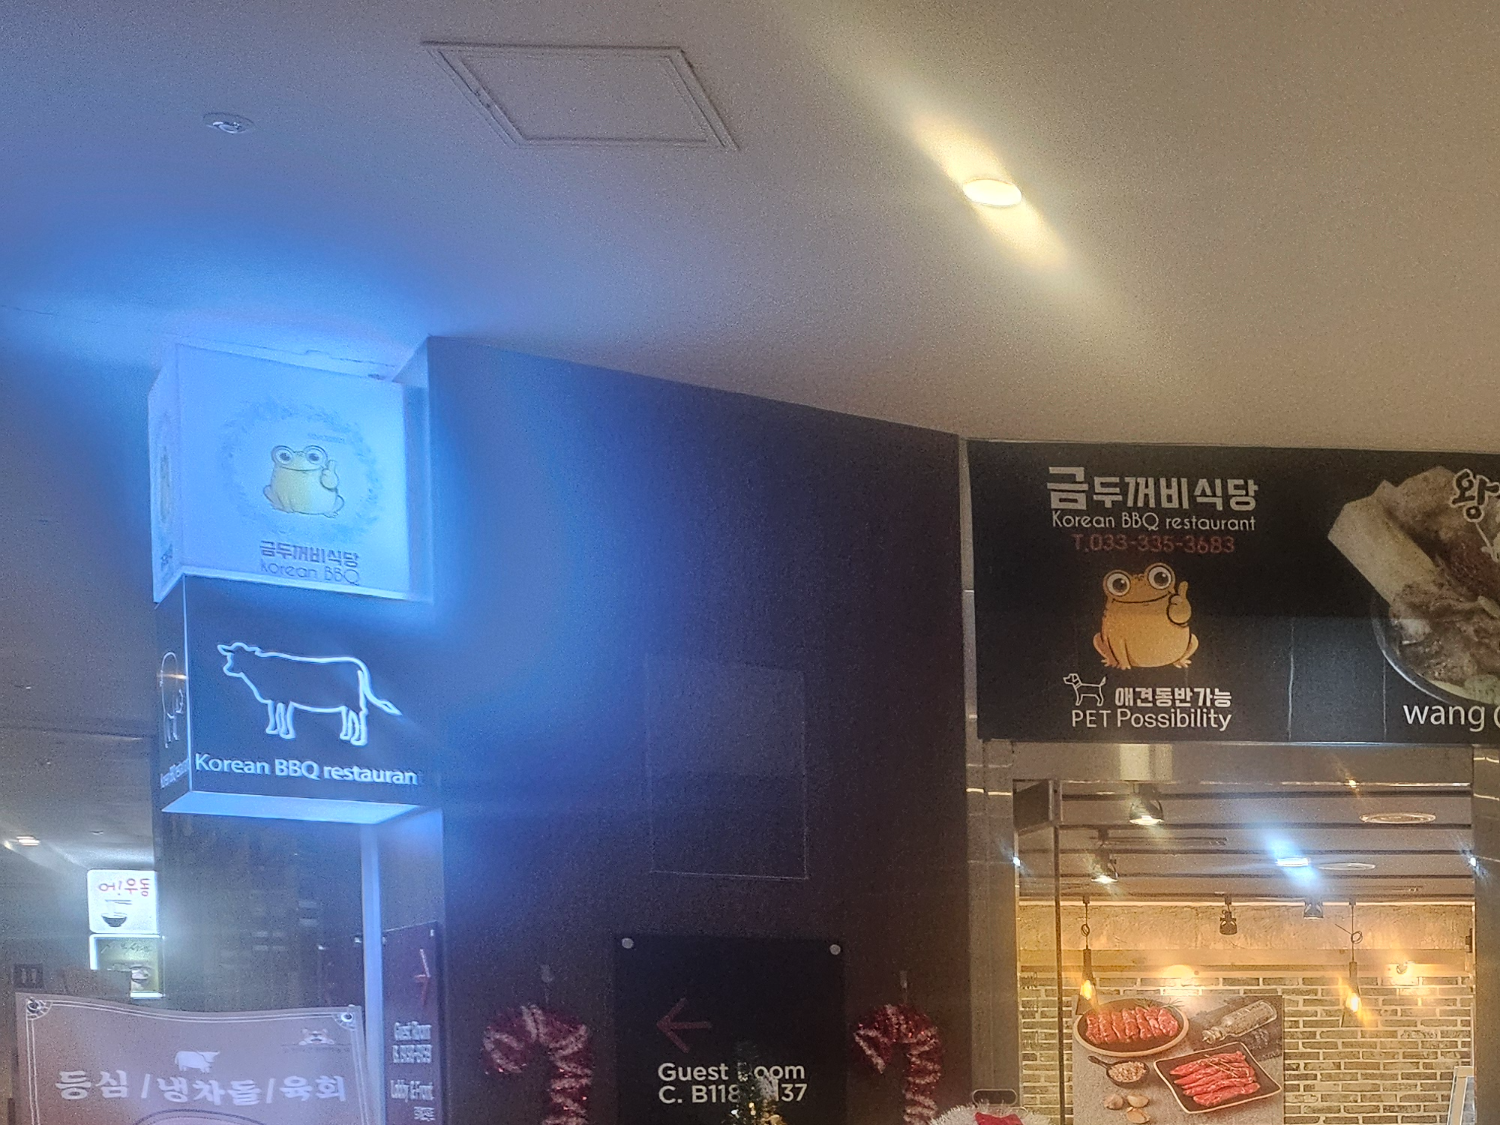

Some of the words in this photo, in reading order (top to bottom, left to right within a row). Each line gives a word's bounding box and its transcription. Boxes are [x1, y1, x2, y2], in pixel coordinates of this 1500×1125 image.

[1047, 467, 1259, 511] 금두꺼비식당
[1052, 510, 1115, 529] Korean
[1121, 511, 1160, 531] BBQ
[1165, 515, 1257, 532] restaurant
[259, 540, 360, 568] 금두꺼비식당
[261, 559, 317, 578] Korean
[324, 565, 361, 586] BBQ
[1114, 687, 1233, 708] 애견동반가능
[1072, 710, 1112, 728] PET
[1117, 708, 1233, 732] Possibility
[1403, 704, 1486, 733] wang
[195, 752, 271, 775] Korean
[274, 758, 321, 781] BBQ
[323, 764, 419, 785] restauran
[55, 1070, 128, 1100] 등심
[658, 1062, 729, 1082] Guest
[737, 1063, 806, 1082] oom
[658, 1084, 683, 1104] C.
